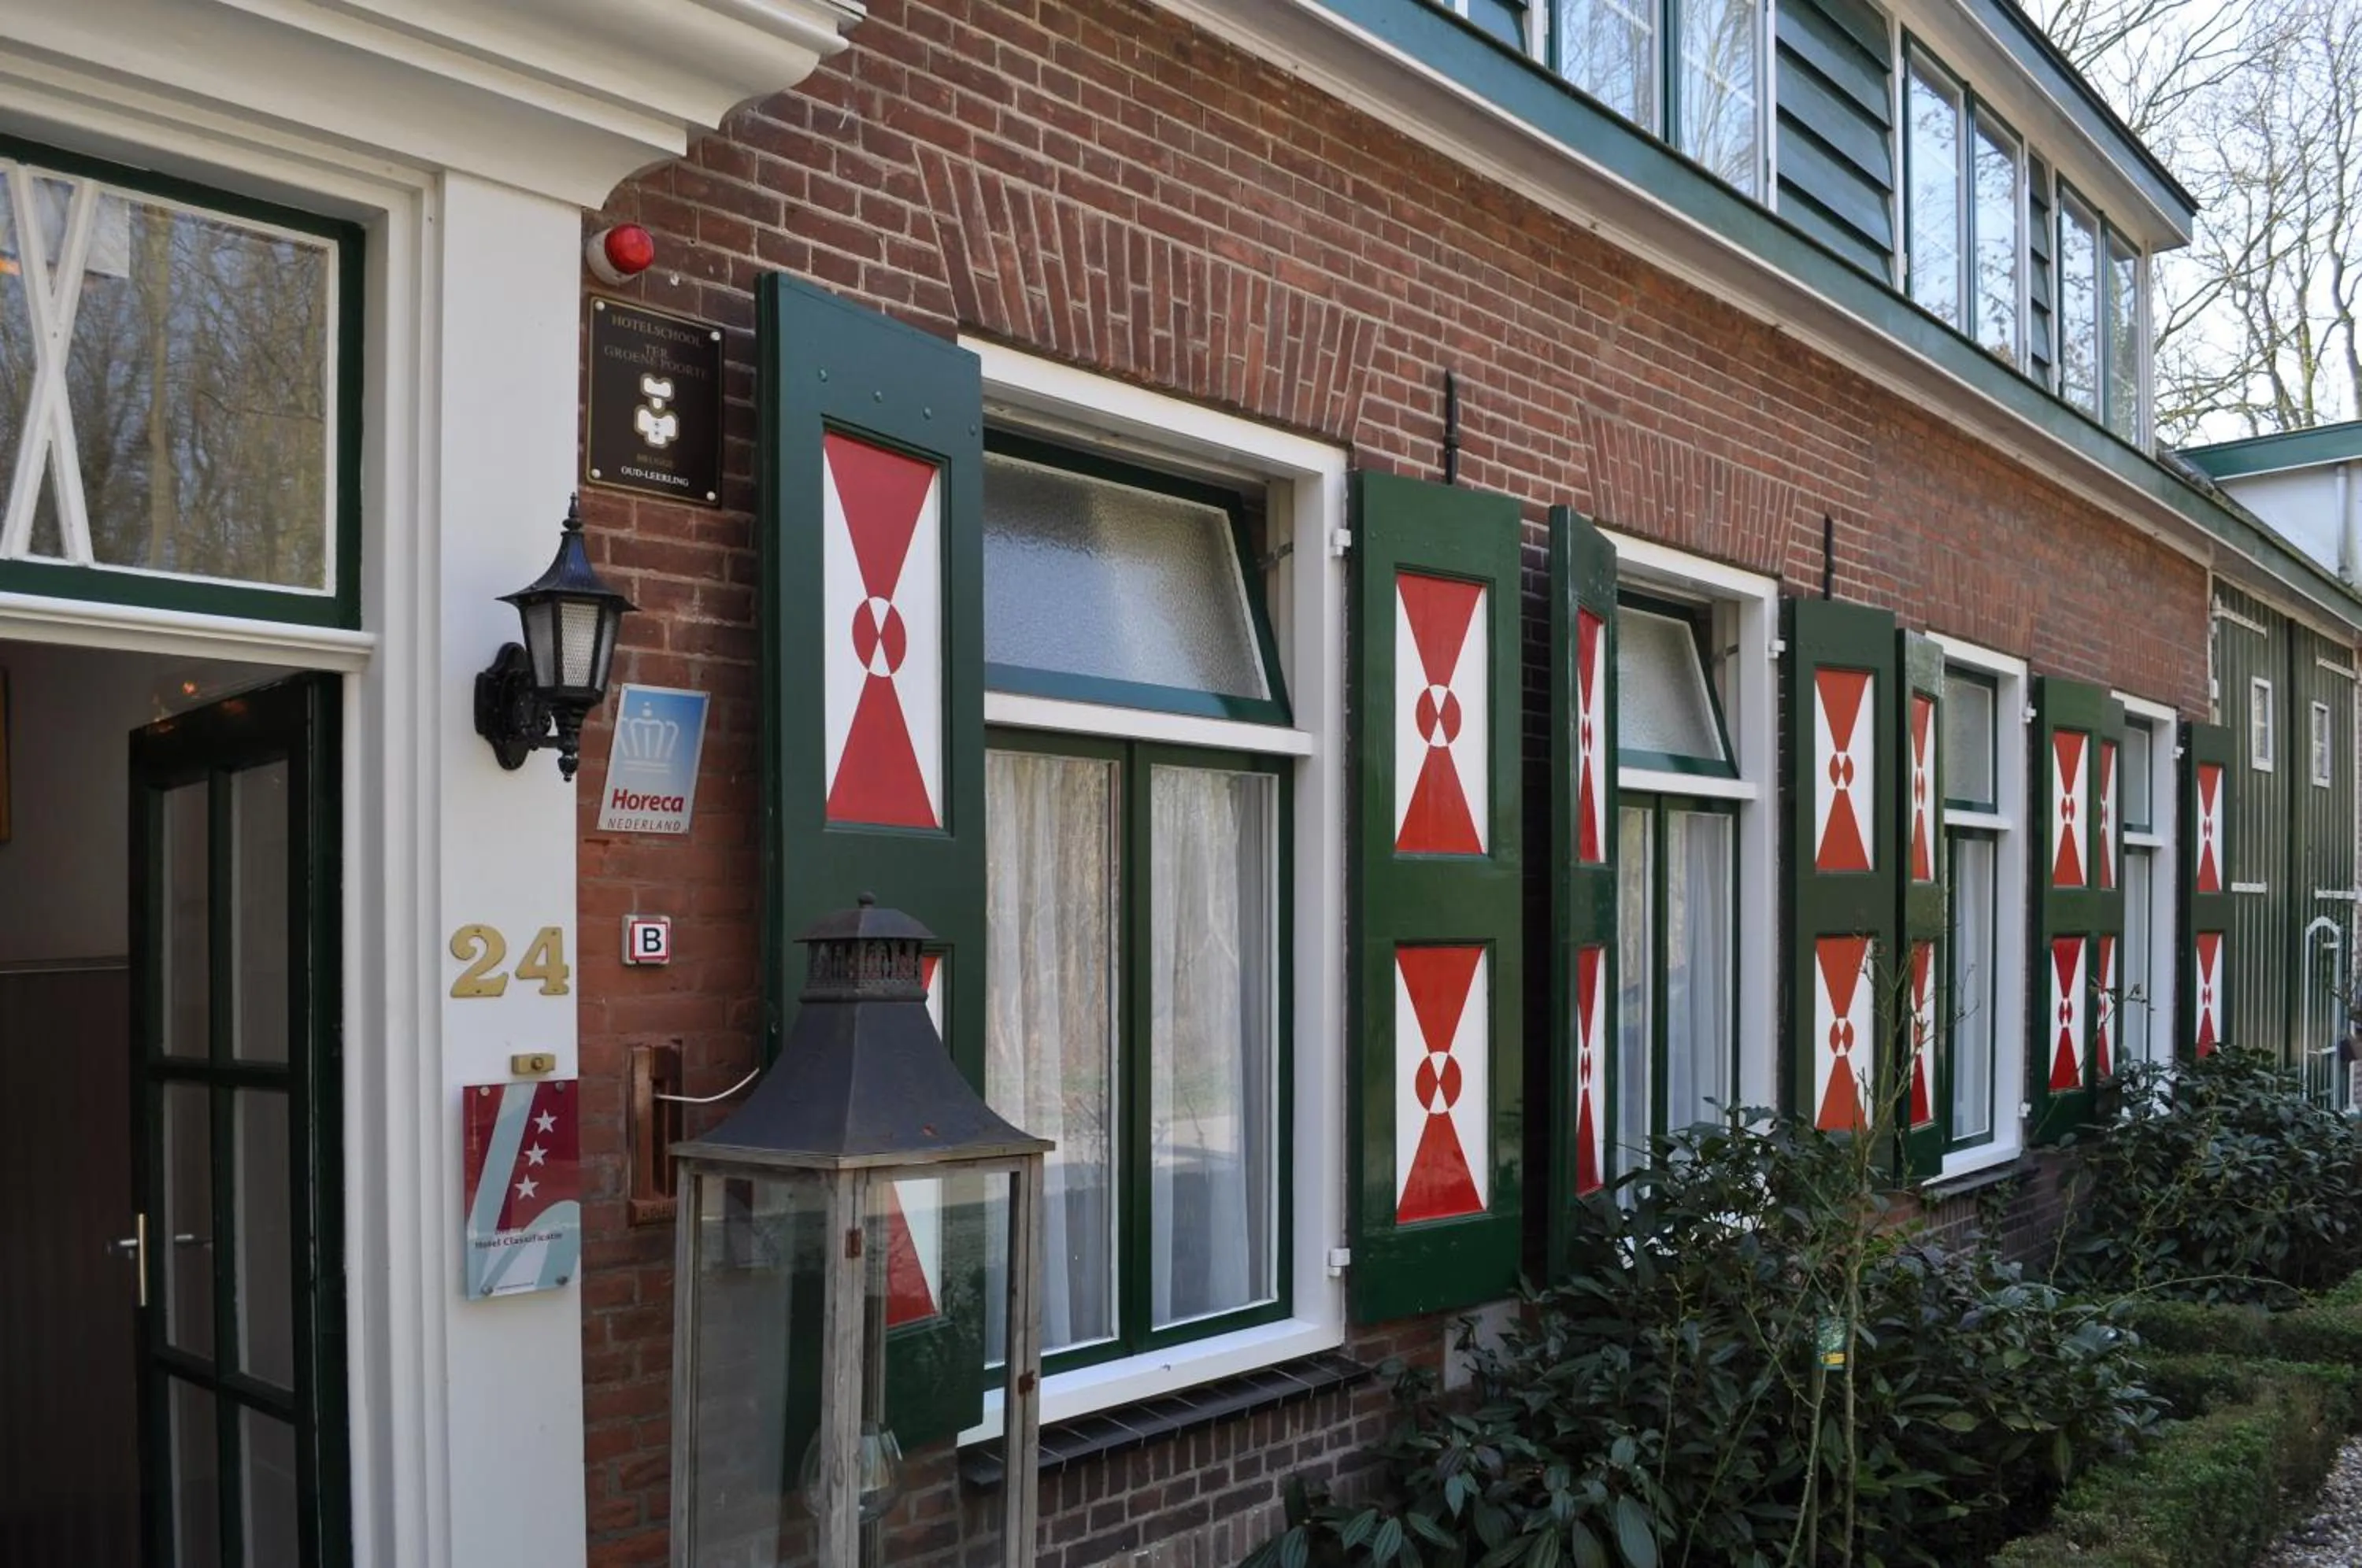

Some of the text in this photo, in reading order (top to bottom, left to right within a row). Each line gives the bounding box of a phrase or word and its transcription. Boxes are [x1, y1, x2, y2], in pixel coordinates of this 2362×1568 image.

[612, 315, 703, 347] HOTELSCHOOL
[604, 344, 654, 366] GROENE
[643, 343, 668, 360] TER
[611, 788, 684, 813] Horeca
[607, 818, 681, 832] NEDERLAND
[642, 926, 662, 953] B
[450, 923, 569, 998] 24
